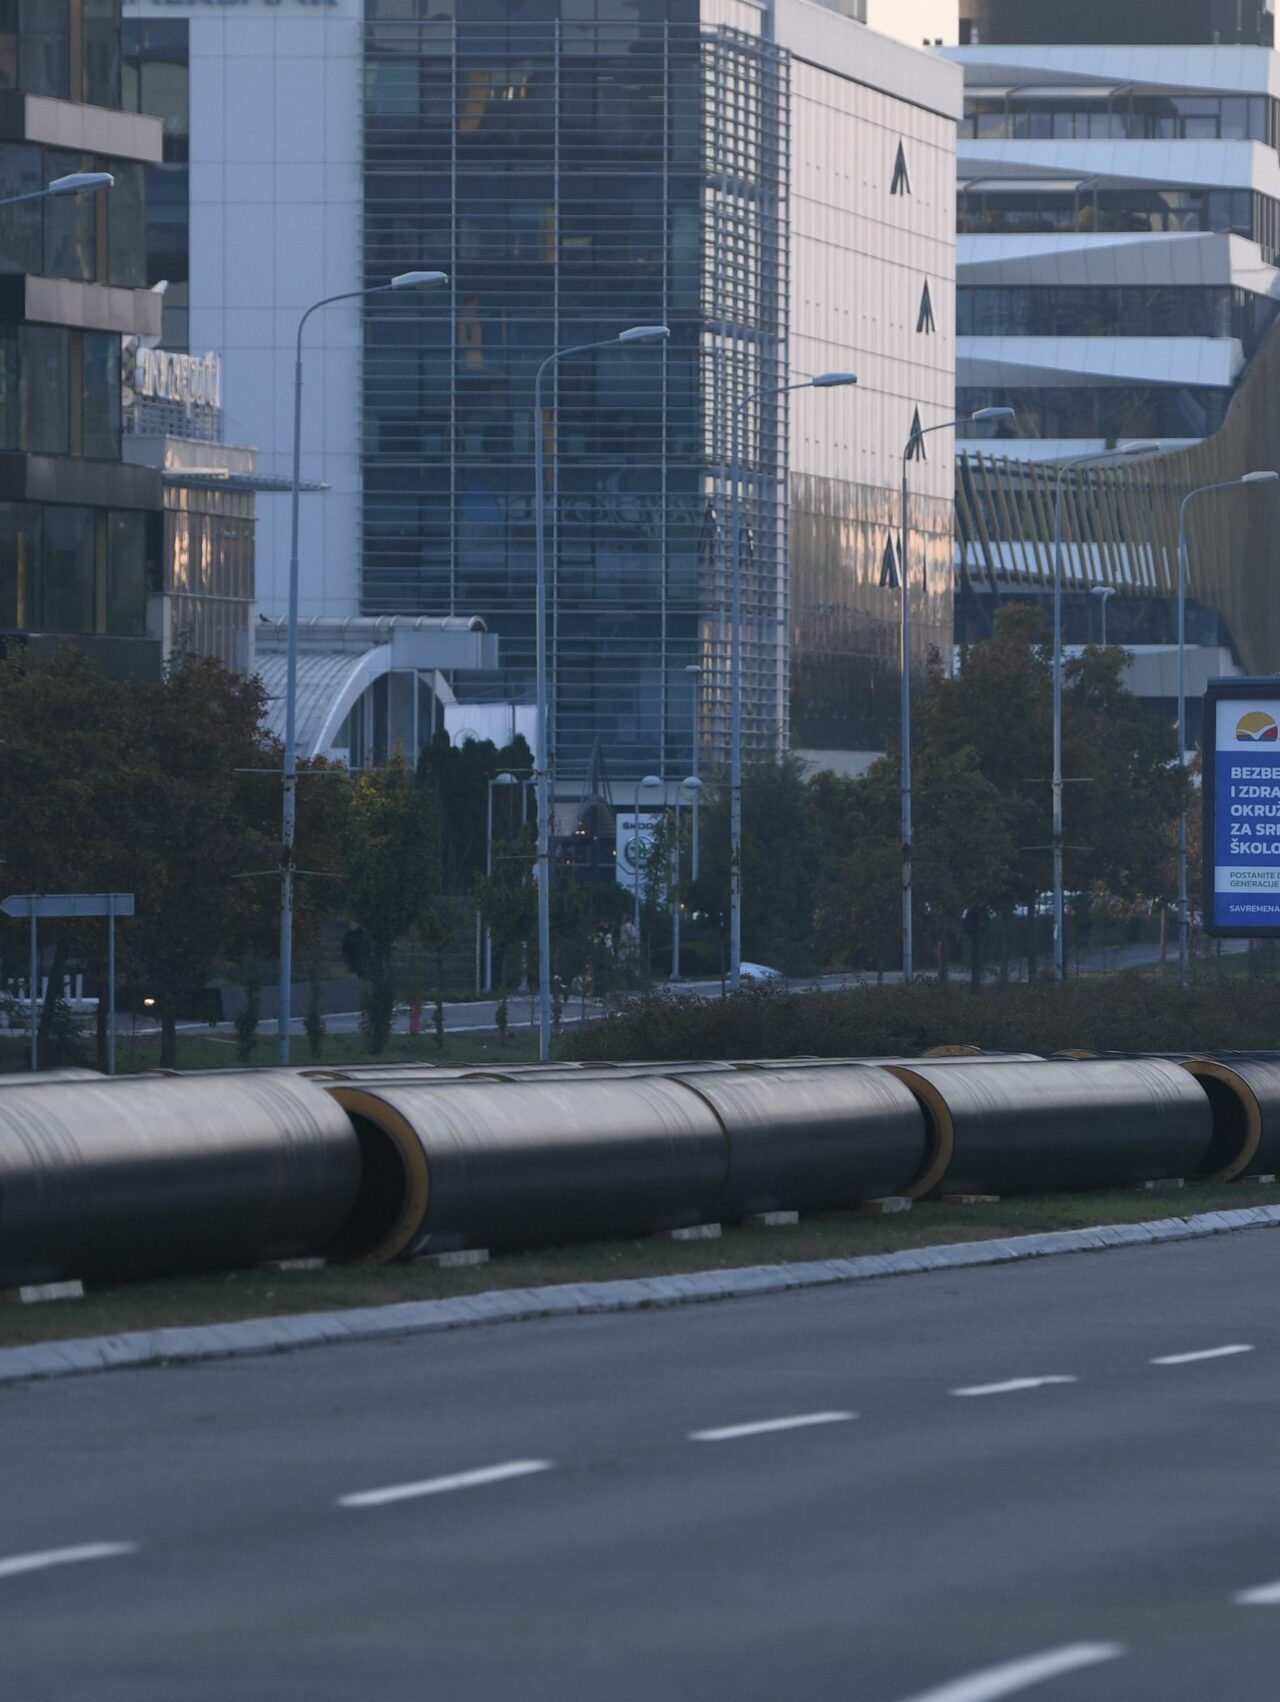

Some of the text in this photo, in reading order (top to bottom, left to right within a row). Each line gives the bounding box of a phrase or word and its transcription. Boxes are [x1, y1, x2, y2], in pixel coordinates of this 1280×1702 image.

[1231, 786, 1235, 798] I
[1230, 823, 1252, 835] ZA
[1230, 880, 1279, 888] GENERACIJE
